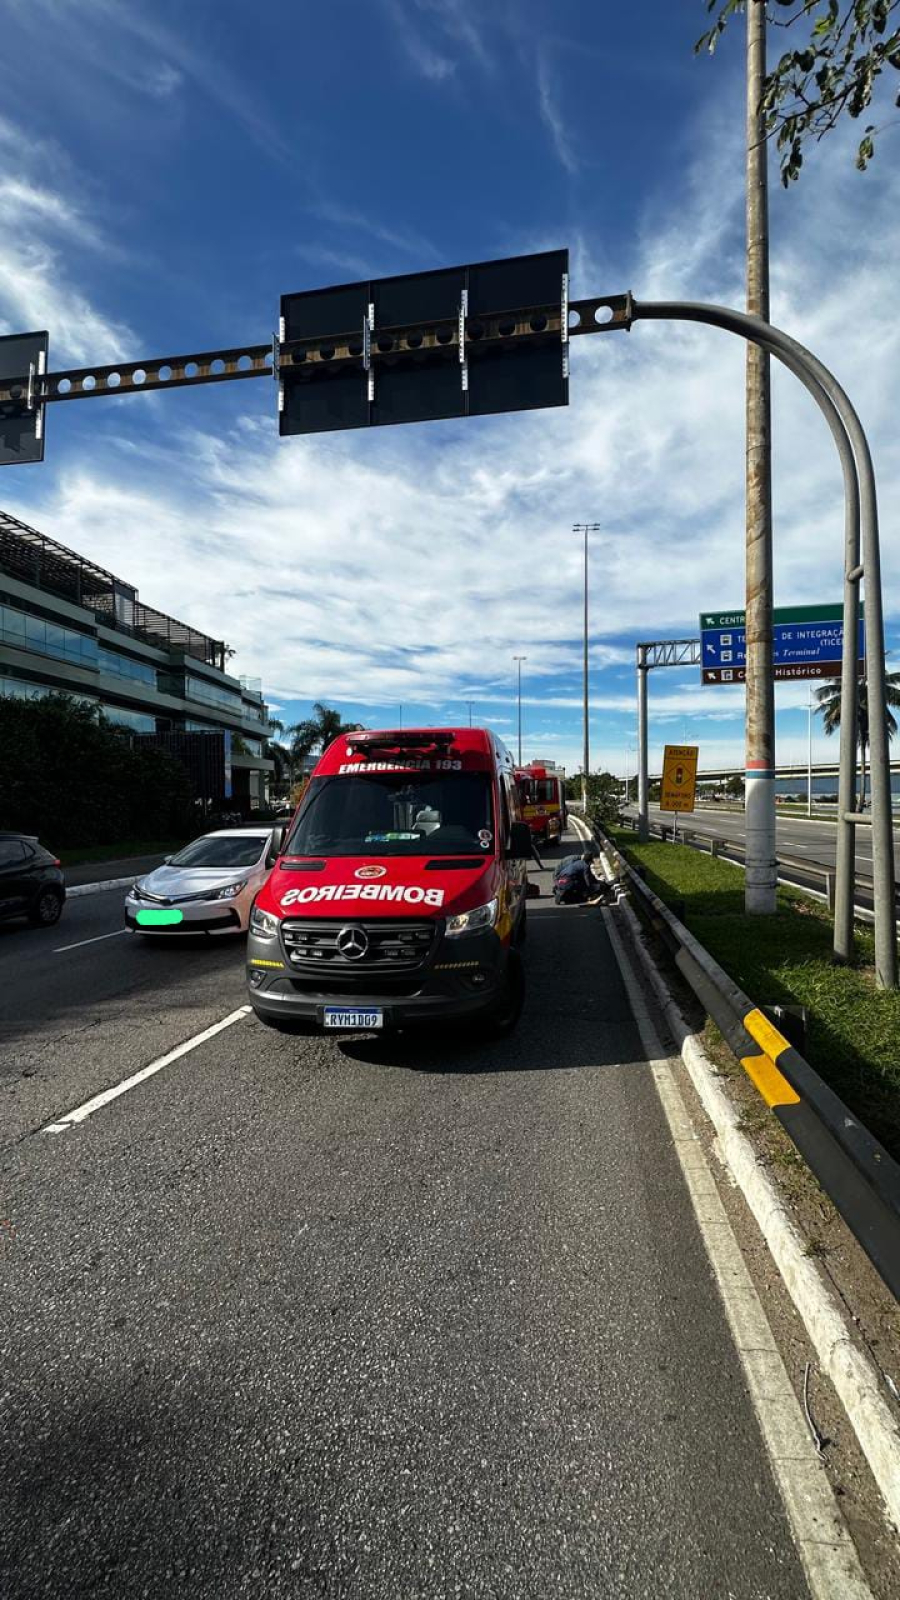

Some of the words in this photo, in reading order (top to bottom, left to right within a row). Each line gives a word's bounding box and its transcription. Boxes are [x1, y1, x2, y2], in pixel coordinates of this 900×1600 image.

[719, 615, 746, 625] CENTR
[781, 631, 793, 641] DE
[796, 626, 844, 640] INTEGRAÇÃ
[783, 646, 821, 657] Terminal
[775, 666, 821, 676] Histórico
[435, 759, 462, 770] 193
